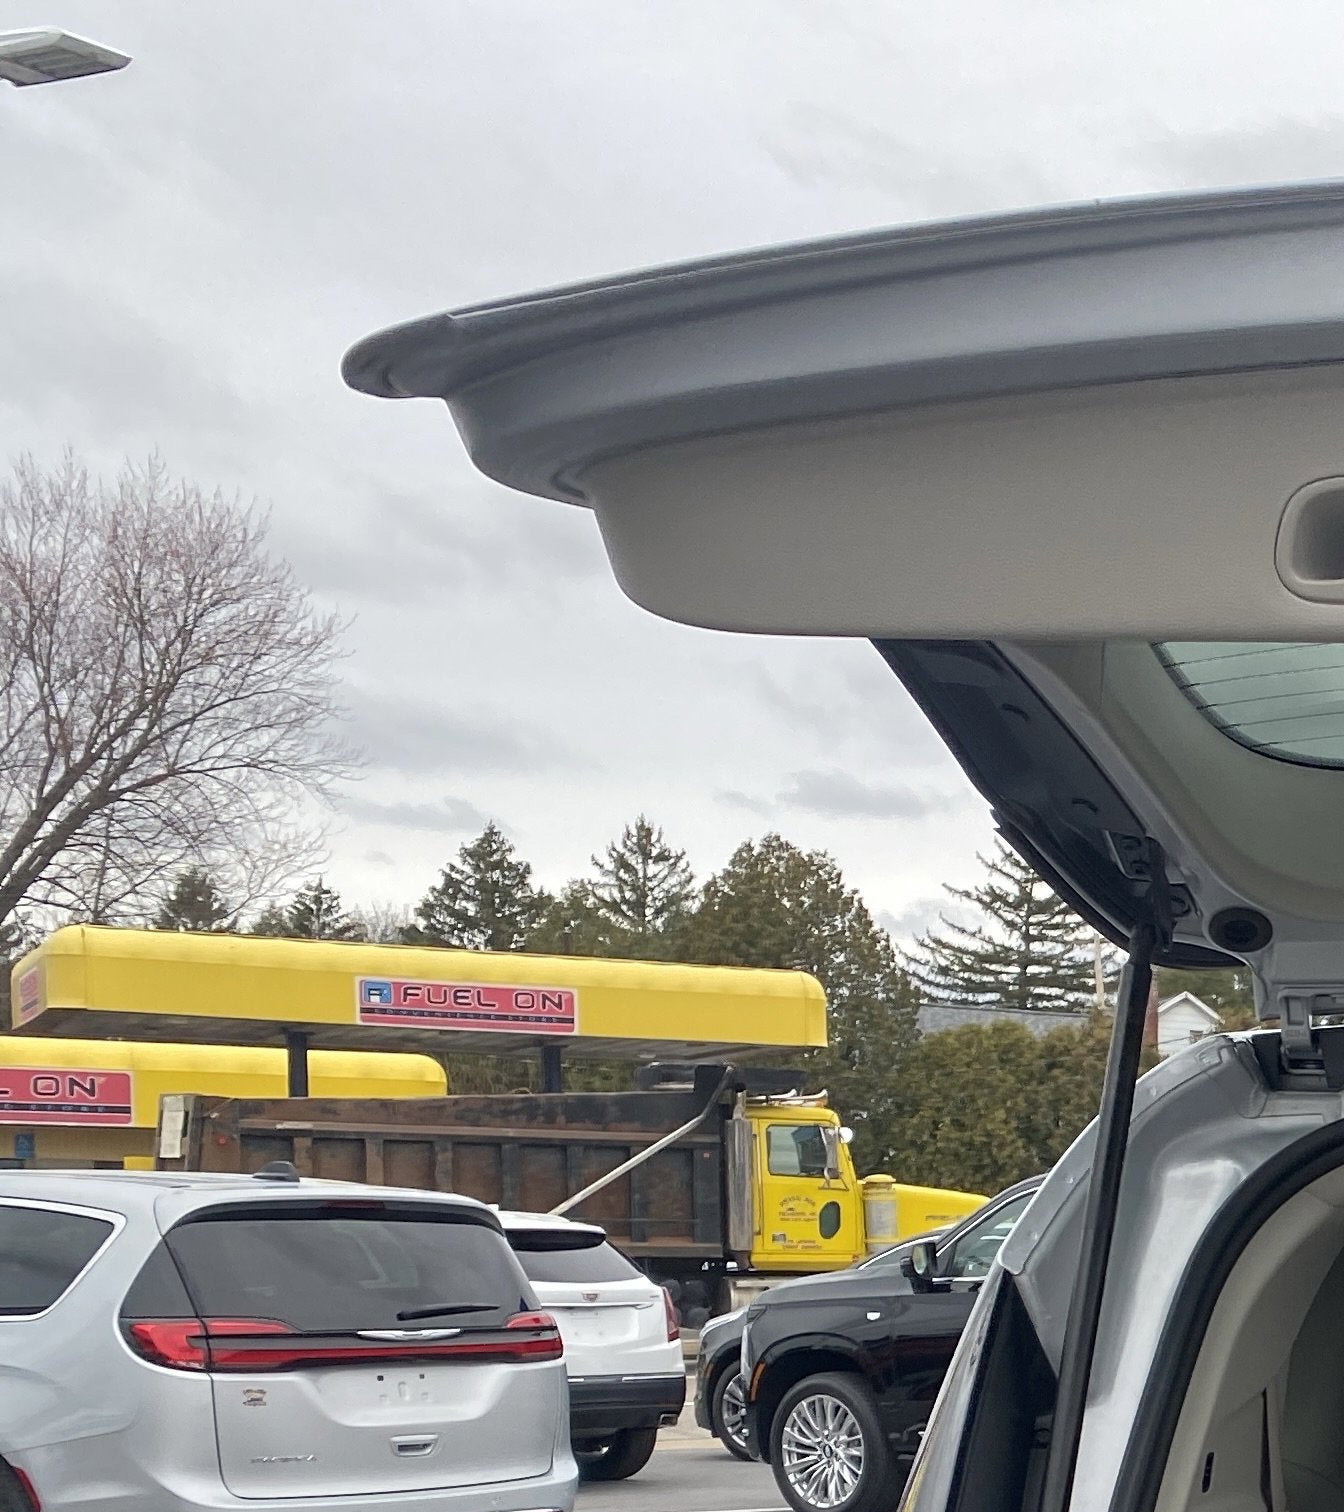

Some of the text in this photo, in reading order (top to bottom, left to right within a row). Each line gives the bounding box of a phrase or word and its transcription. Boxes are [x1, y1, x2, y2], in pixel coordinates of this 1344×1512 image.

[402, 985, 564, 1011] FUEL ON
[32, 1076, 97, 1098] ON
